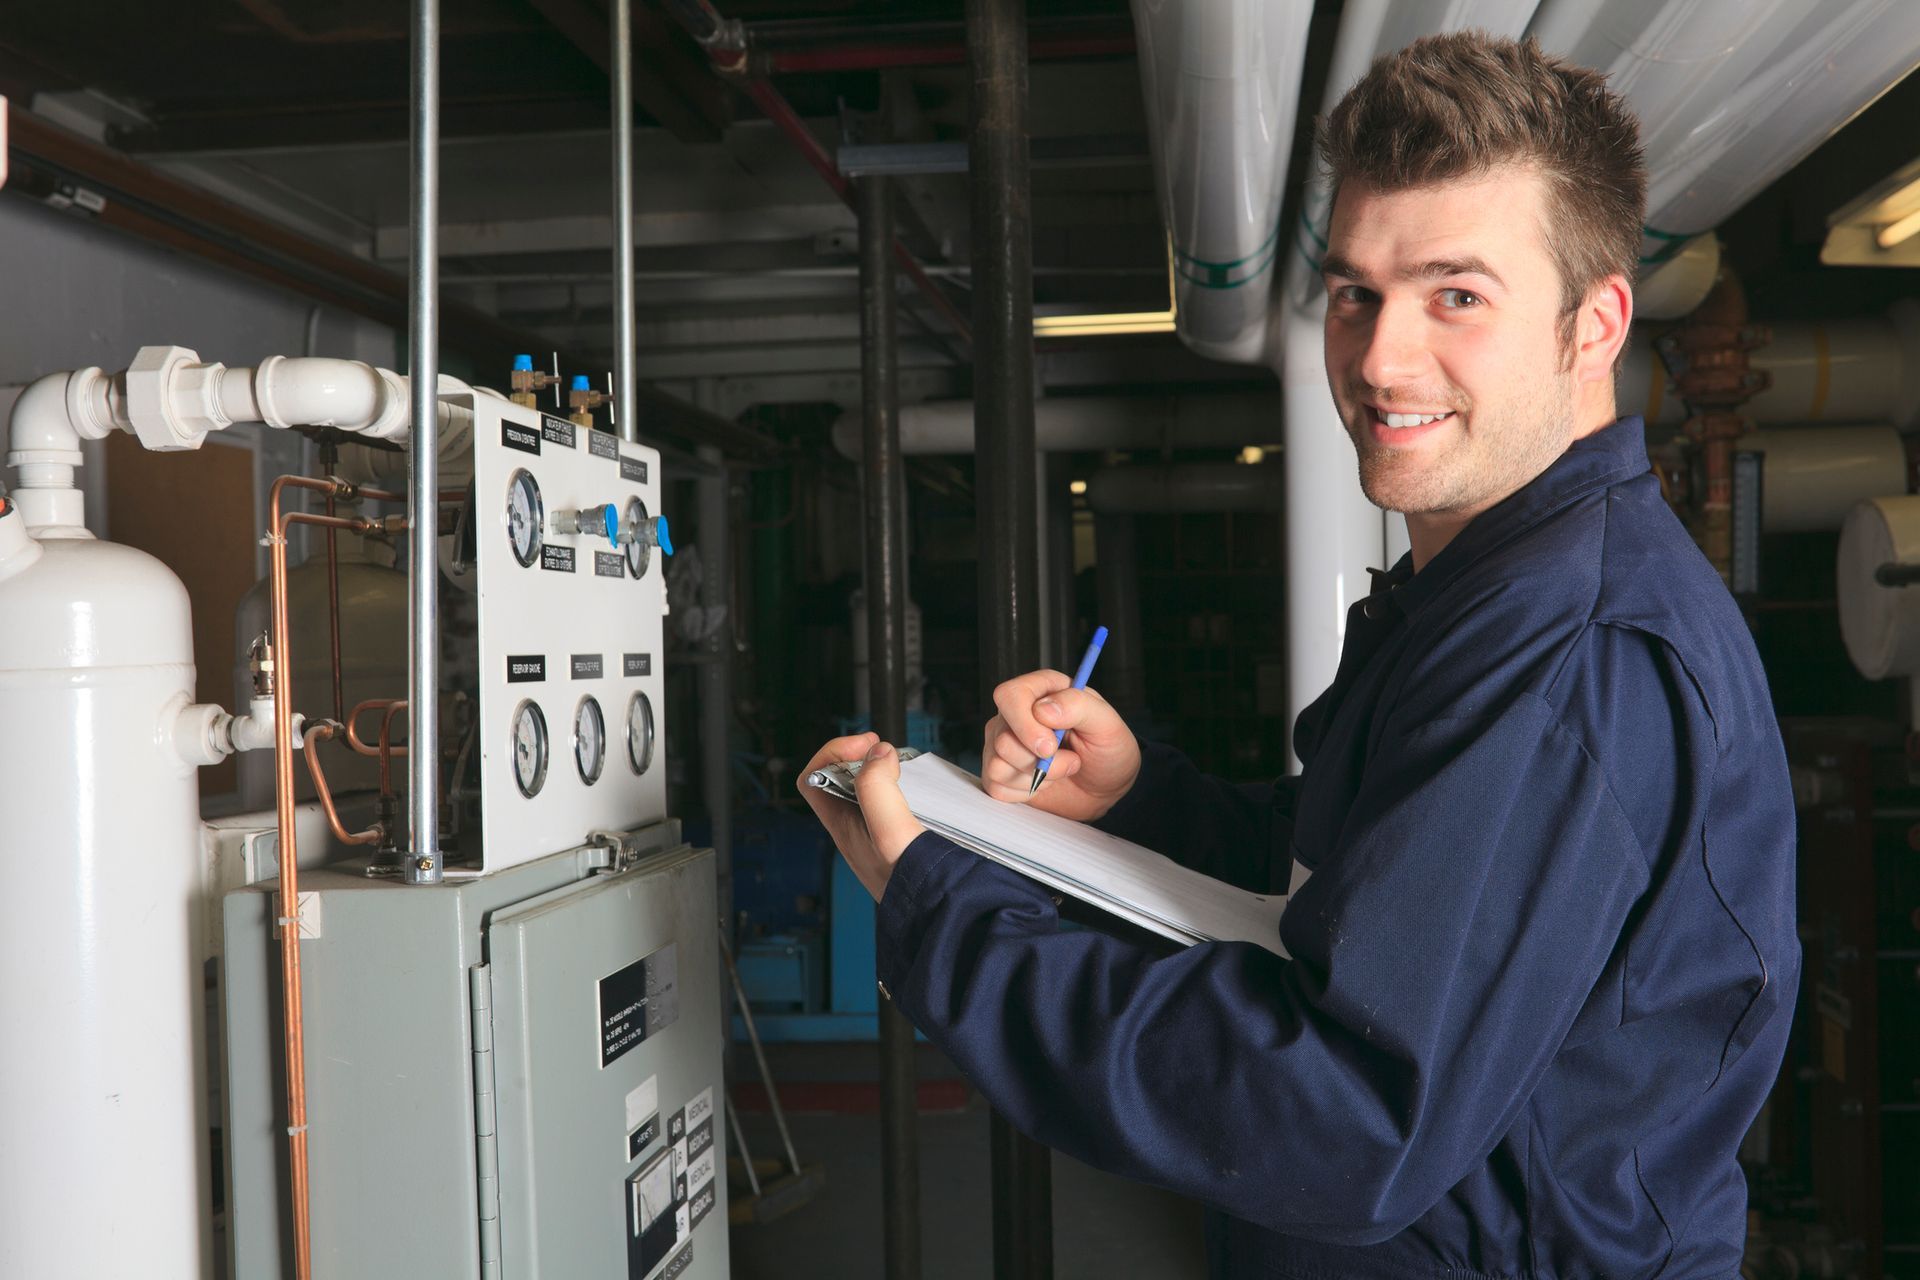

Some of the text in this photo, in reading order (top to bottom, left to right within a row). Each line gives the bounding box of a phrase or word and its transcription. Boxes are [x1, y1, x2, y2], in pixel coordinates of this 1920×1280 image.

[512, 663, 541, 674] RESERVOIR GAUCHE
[672, 1117, 682, 1137] AIR
